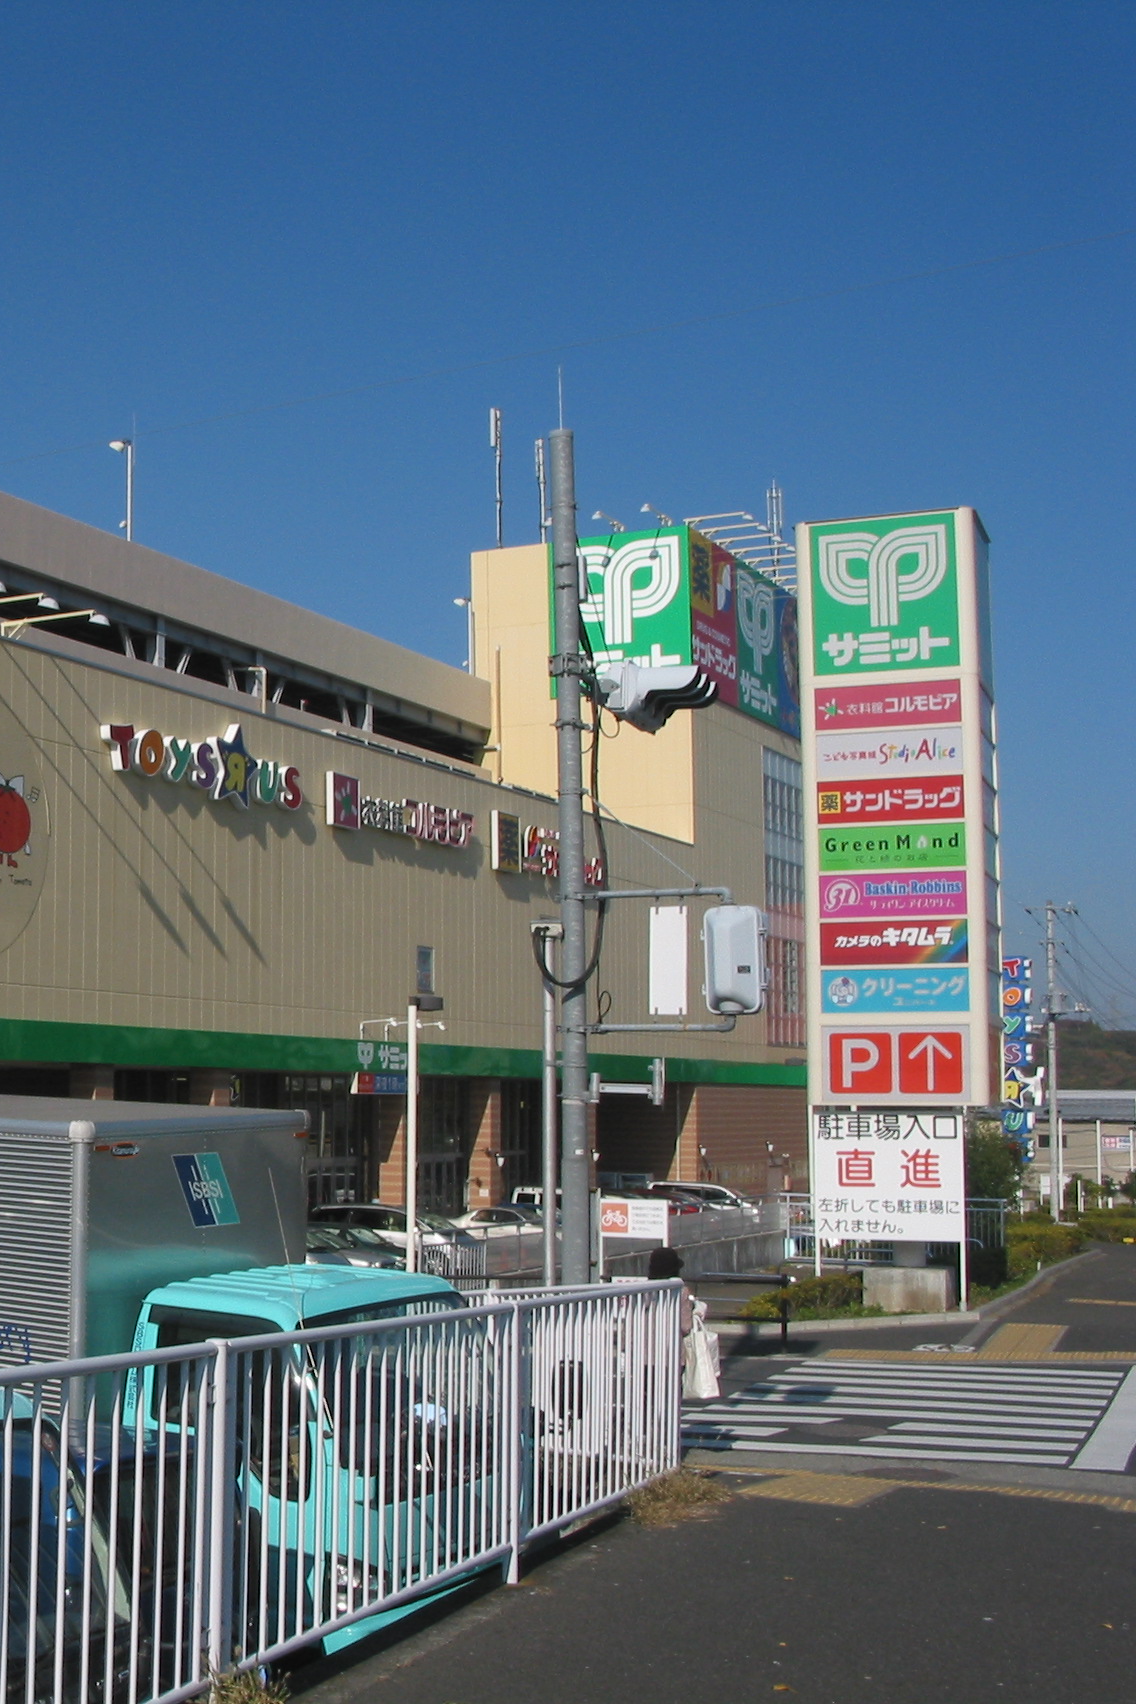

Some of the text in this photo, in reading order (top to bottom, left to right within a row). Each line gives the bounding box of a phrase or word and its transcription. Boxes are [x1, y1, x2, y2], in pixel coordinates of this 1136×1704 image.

[822, 627, 950, 666] サミット
[740, 669, 777, 716] サミット
[915, 737, 956, 761] Alice
[100, 723, 214, 790] TOYS
[255, 758, 303, 811] US
[844, 786, 961, 813] サンドラッグ
[825, 838, 889, 852] Green
[834, 926, 952, 948] カメラのキタムラ
[862, 975, 967, 997] クリーニング
[378, 1044, 408, 1070] サミッ
[842, 1038, 880, 1088] P
[817, 1114, 958, 1141] 駐車場入口
[836, 1148, 942, 1188] 直進
[193, 1180, 220, 1200] SBS
[818, 1198, 961, 1214] 左折しても駐車場に
[819, 1219, 904, 1234] 入れません。
